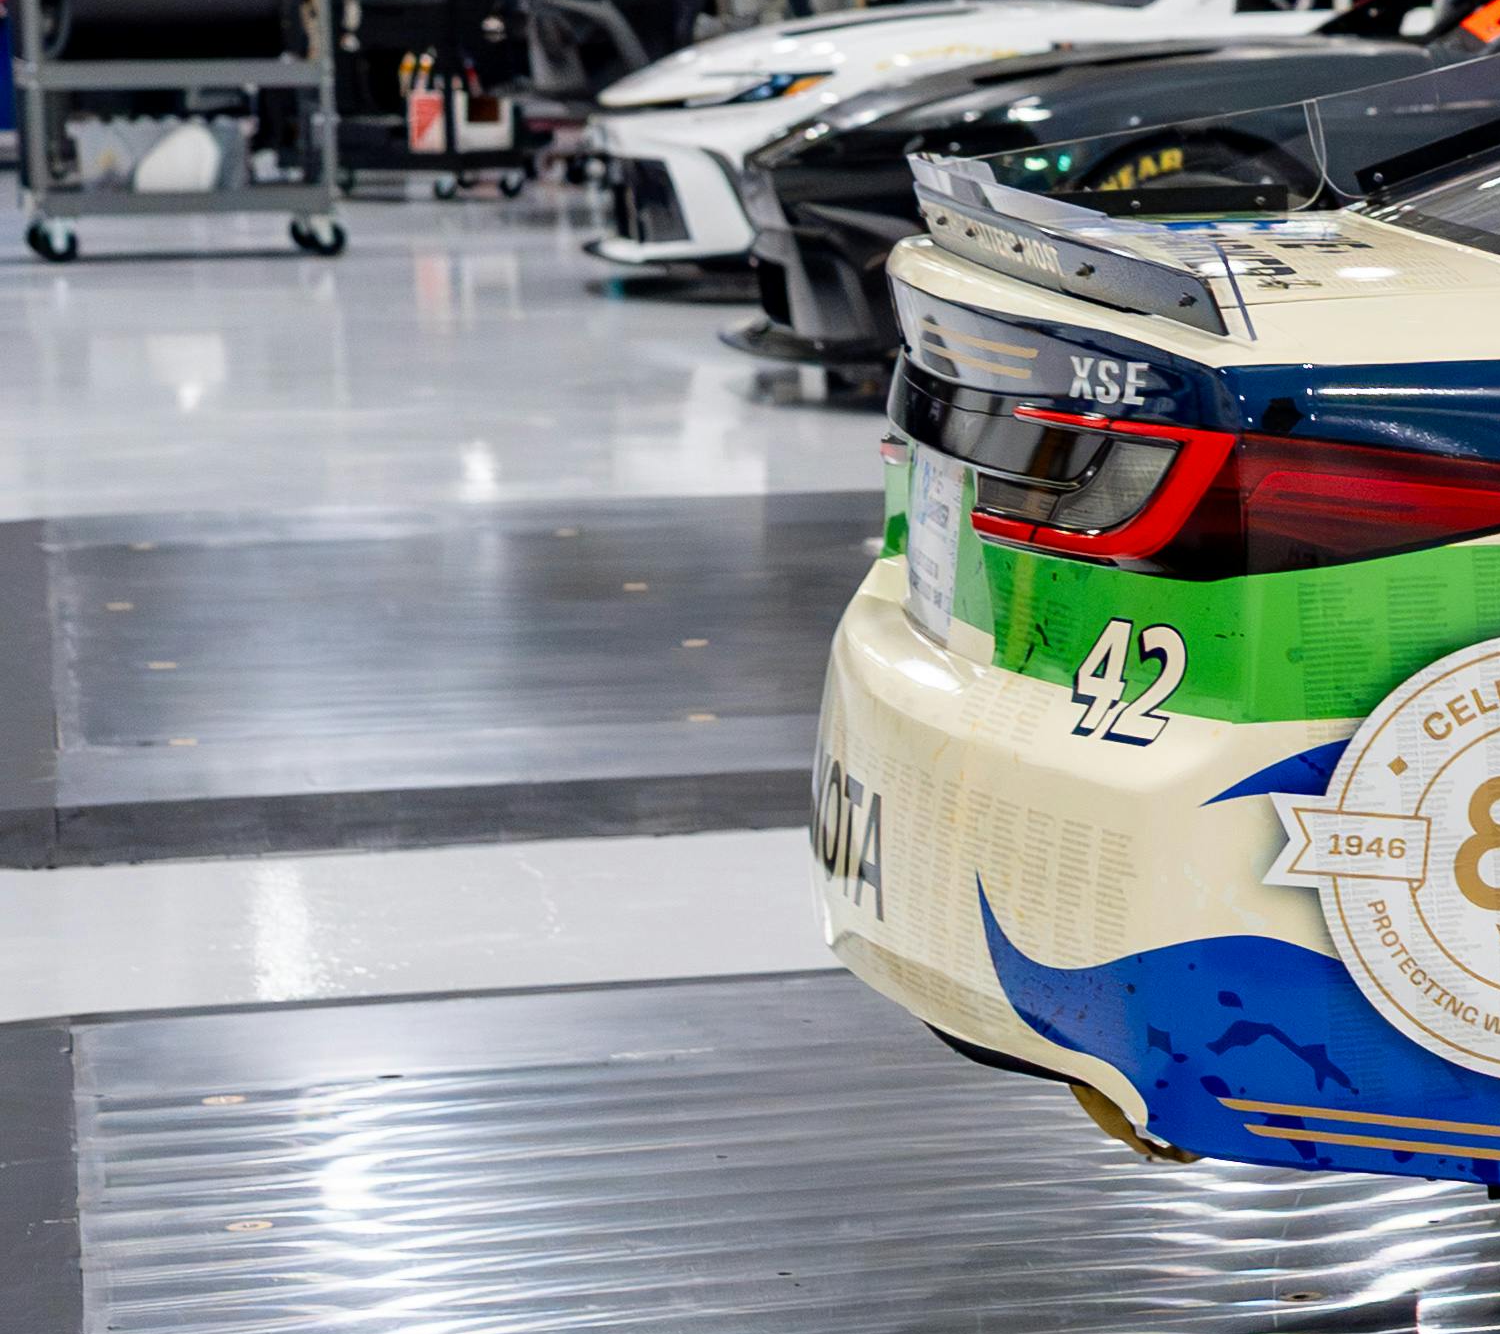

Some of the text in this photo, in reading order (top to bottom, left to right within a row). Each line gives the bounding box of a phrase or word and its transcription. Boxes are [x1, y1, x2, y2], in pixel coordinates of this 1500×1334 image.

[1068, 354, 1151, 406] XSE
[1071, 617, 1188, 748] 42
[1327, 833, 1407, 860] 1946
[1367, 899, 1481, 1026] PROTECTING
